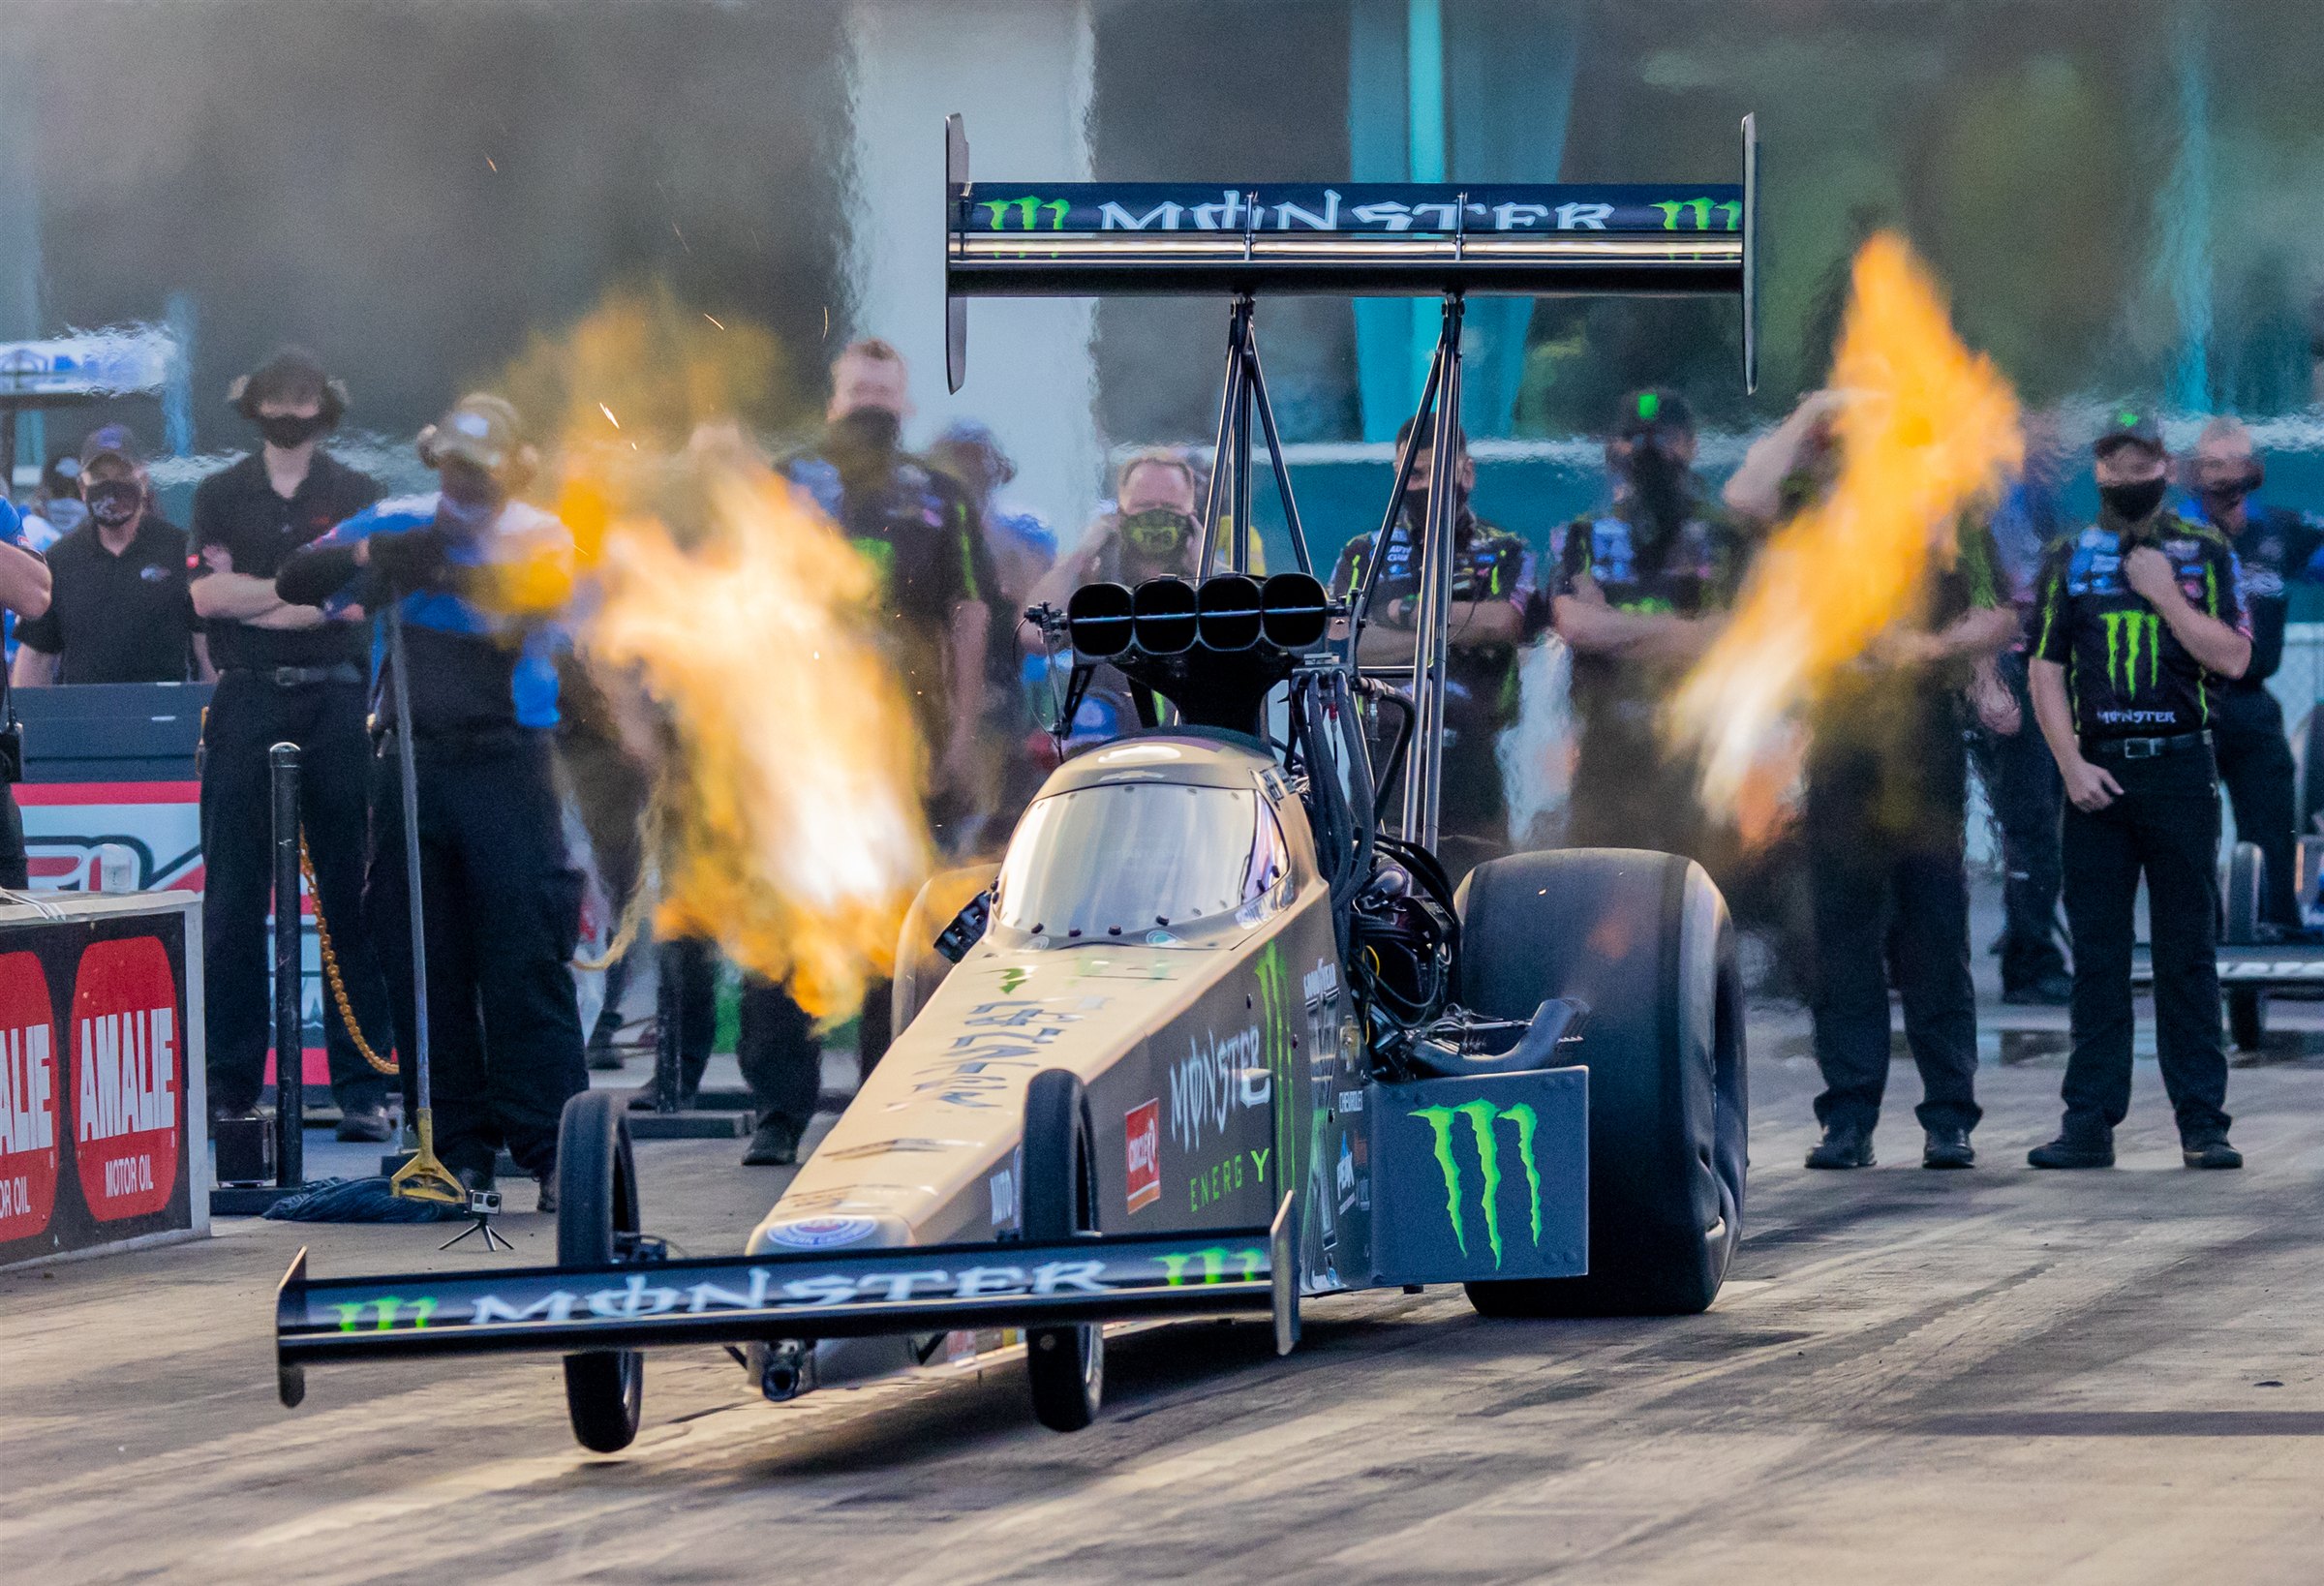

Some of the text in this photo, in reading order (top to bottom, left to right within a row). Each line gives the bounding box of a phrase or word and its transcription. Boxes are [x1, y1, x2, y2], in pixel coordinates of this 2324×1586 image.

[1097, 189, 1616, 230] MONSTER
[2096, 709, 2177, 724] MONSTER
[80, 1007, 175, 1143] AMALIE
[14, 1176, 31, 1216] OIL
[106, 1154, 154, 1198] MOTOR OIL
[1190, 1148, 1269, 1212] ENERGY
[470, 1260, 1120, 1325] MONSTER
